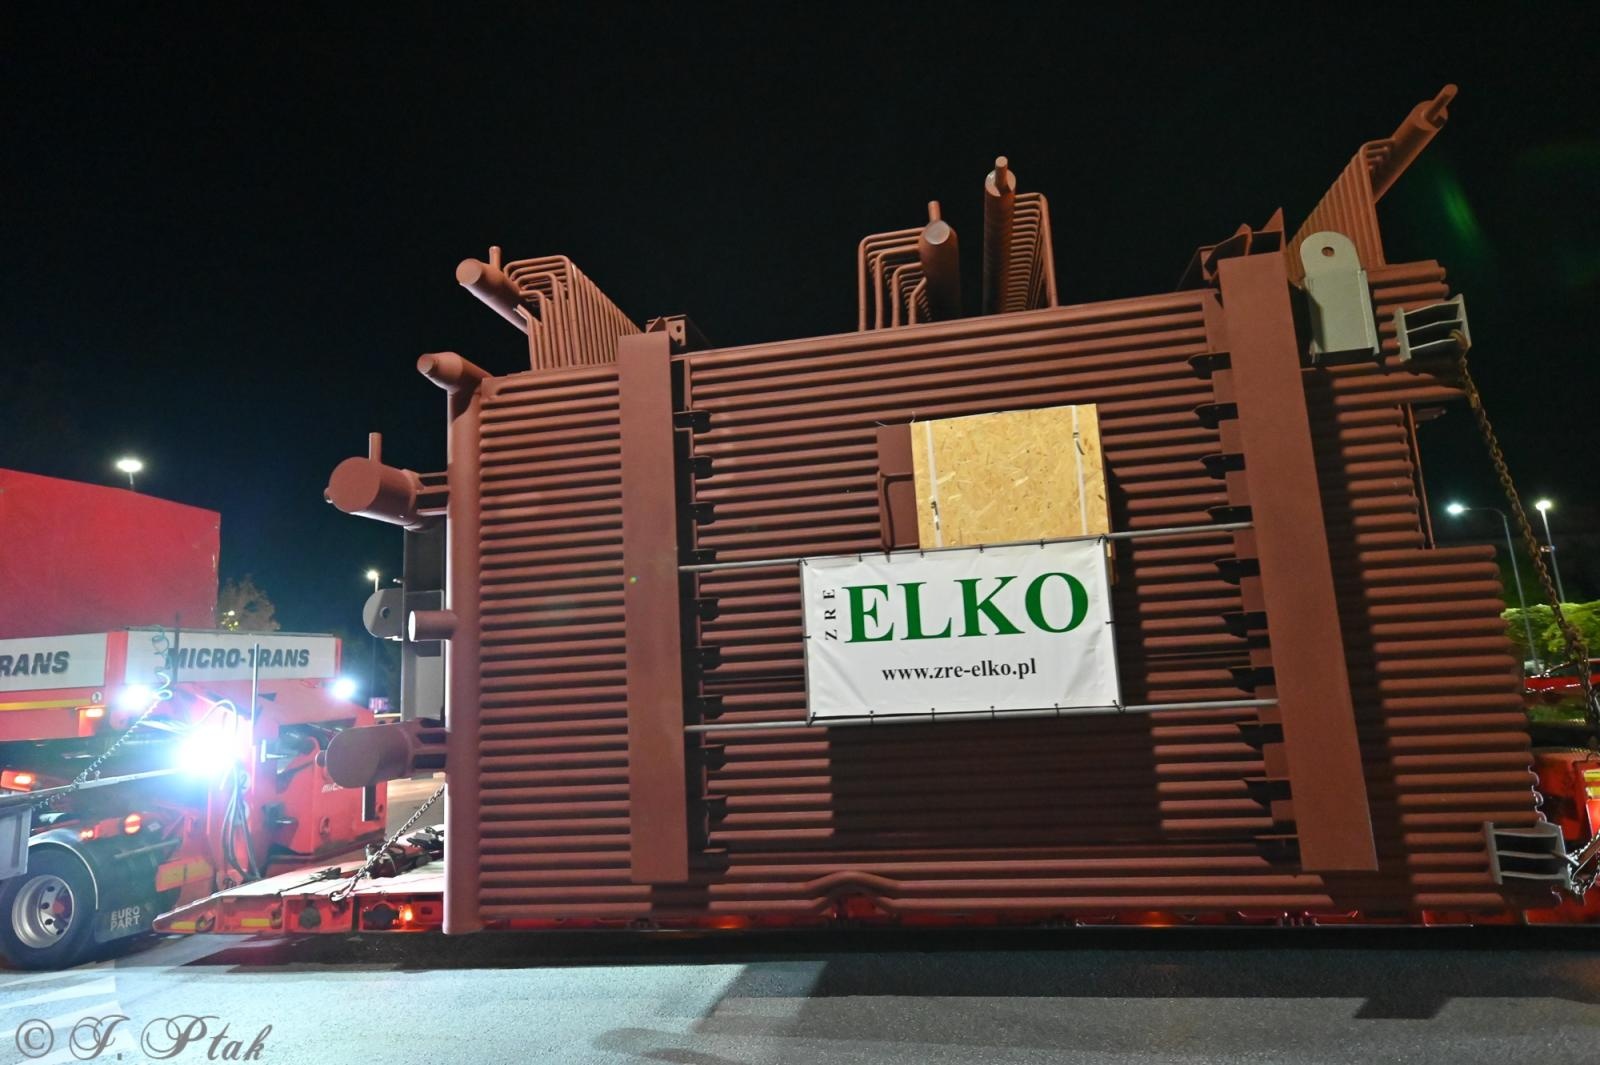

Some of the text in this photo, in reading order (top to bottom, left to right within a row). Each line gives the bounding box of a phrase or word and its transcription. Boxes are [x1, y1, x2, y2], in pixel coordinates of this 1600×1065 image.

[822, 588, 838, 641] ZRE
[841, 572, 1089, 643] ELKO
[882, 658, 1037, 680] www.zre-elko.pl
[110, 914, 141, 931] PART
[111, 905, 141, 921] EURO
